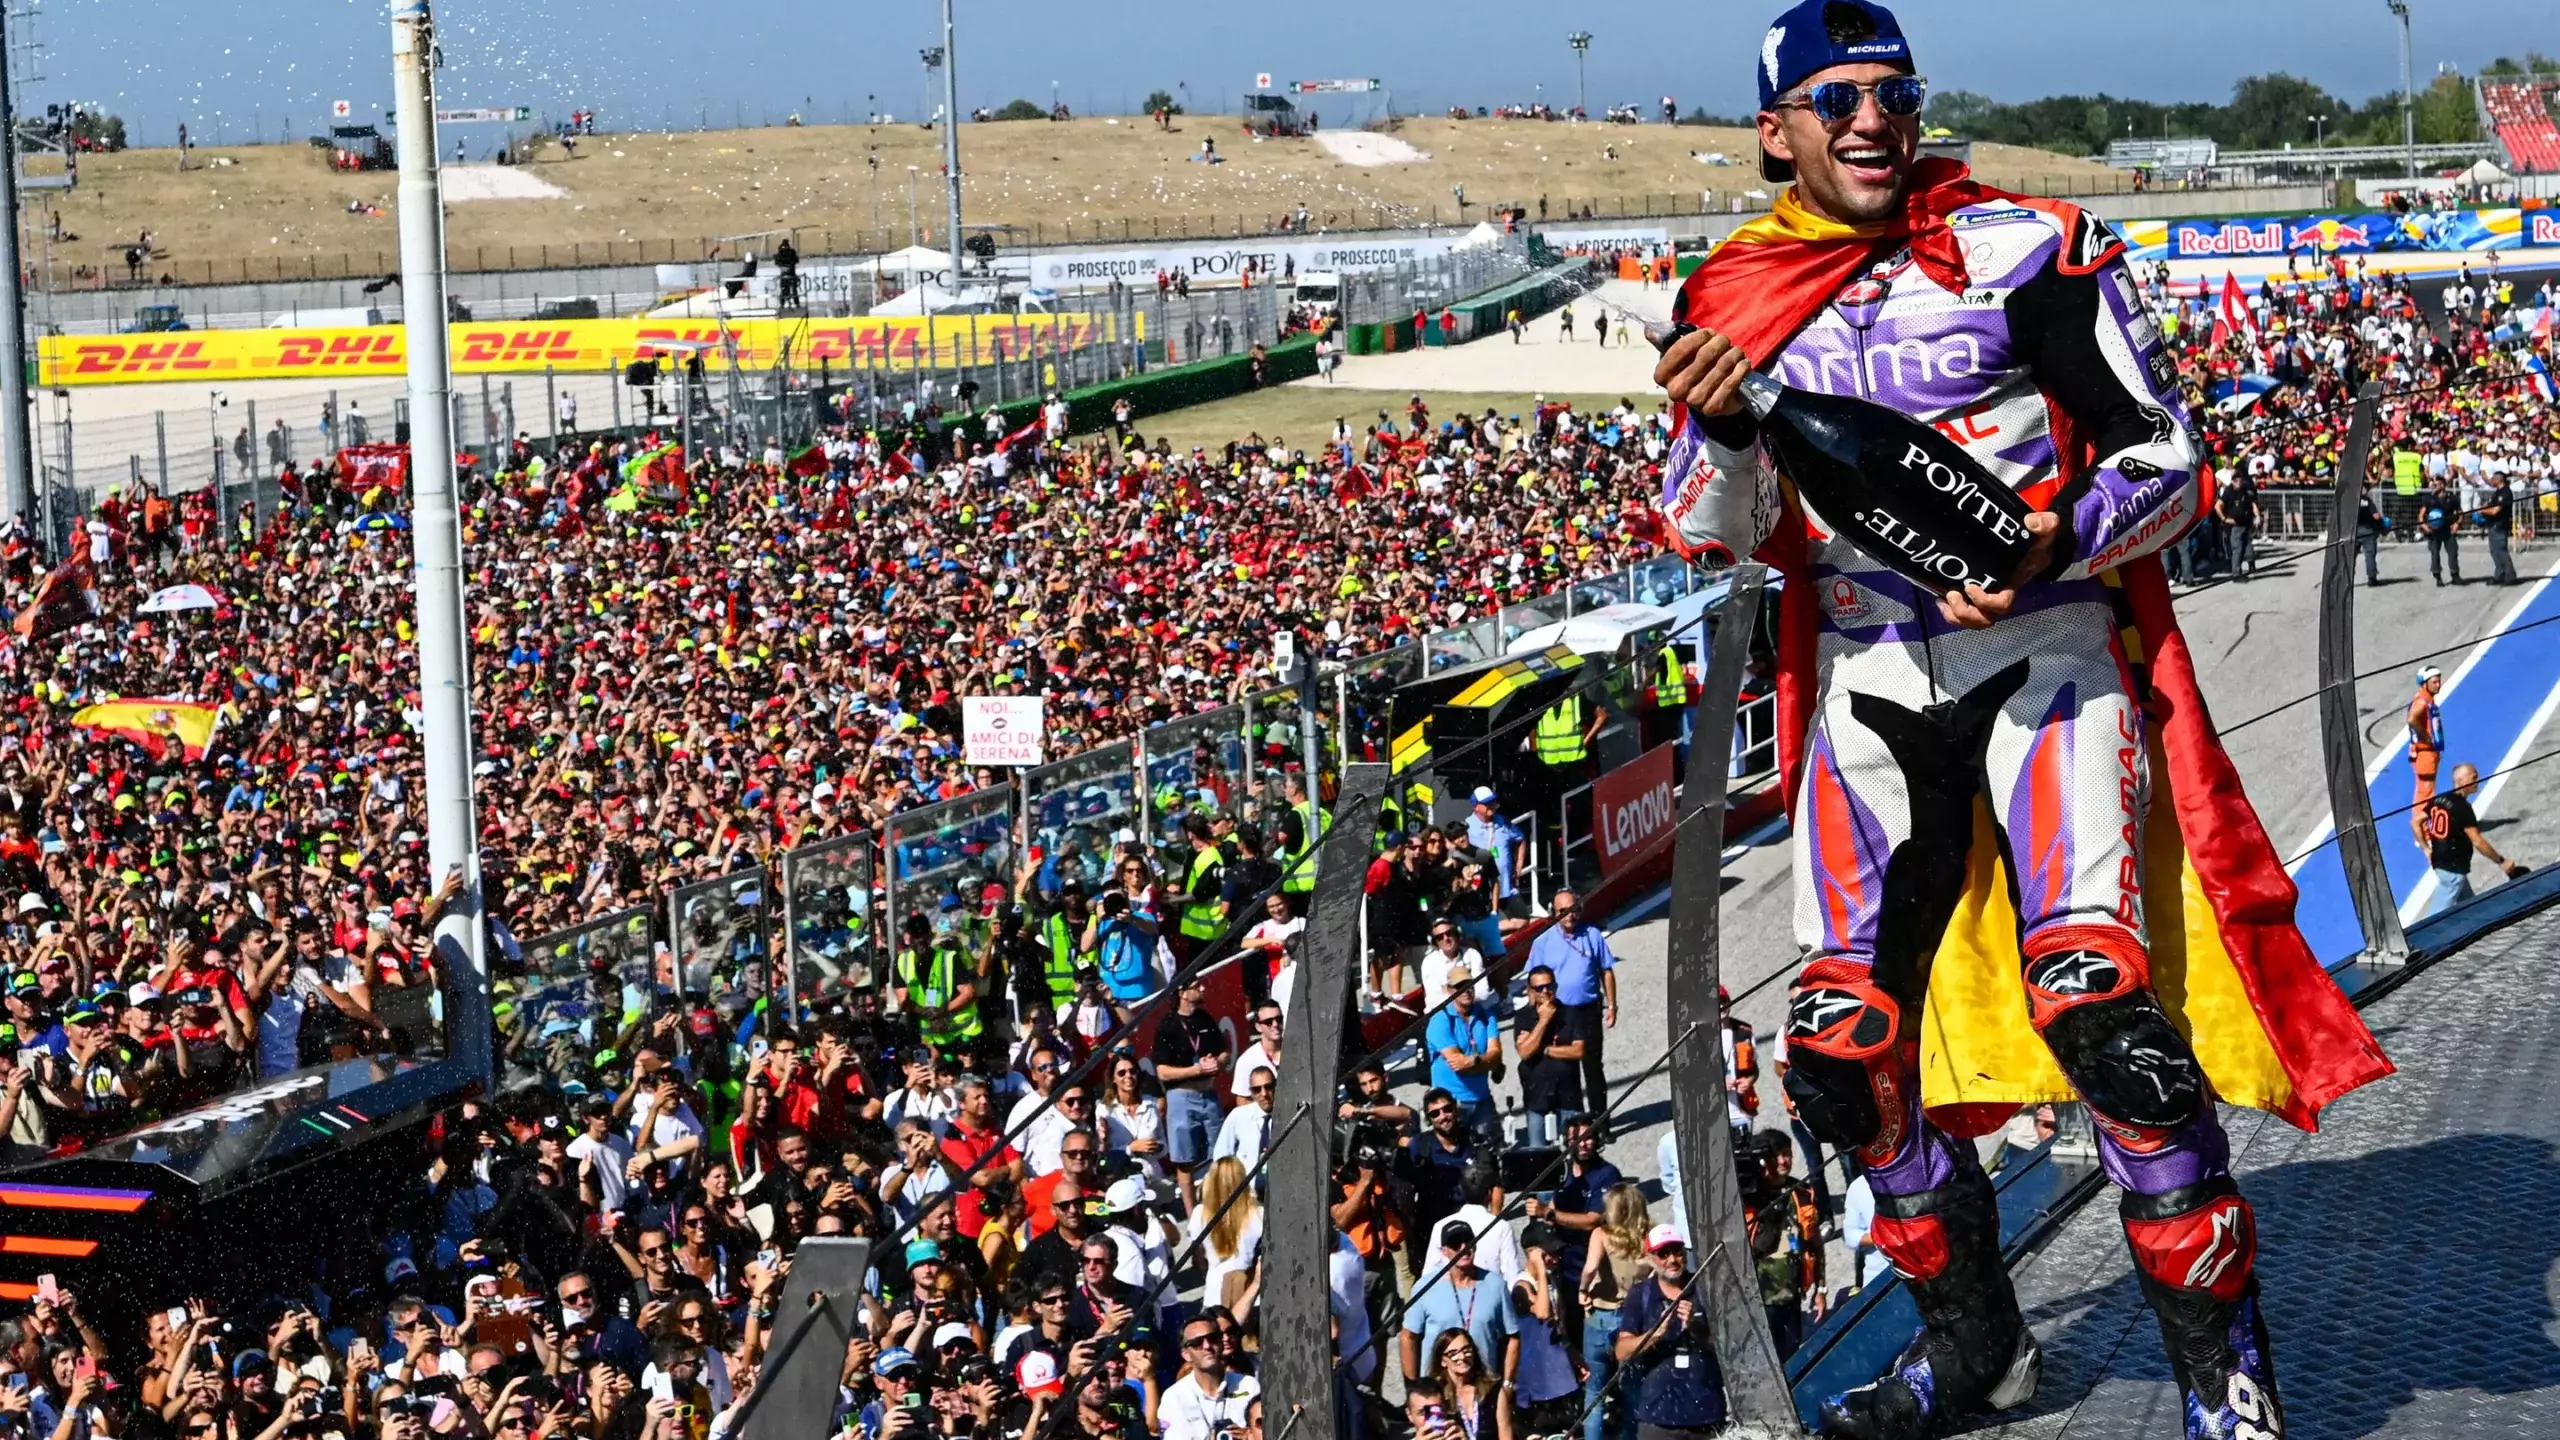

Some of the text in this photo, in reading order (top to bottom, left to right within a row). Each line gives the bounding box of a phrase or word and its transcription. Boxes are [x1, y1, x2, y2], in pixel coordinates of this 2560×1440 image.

[1847, 43, 1900, 54] MICHELIN
[1971, 210, 2029, 223] MICHELIN
[2180, 223, 2282, 253] Red Bull
[1068, 260, 1136, 278] PROSECCO
[1331, 248, 1396, 266] PROSECCO
[76, 341, 213, 373] DHL
[277, 336, 401, 366] DHL
[462, 331, 578, 360] DHL
[810, 327, 929, 359] DHL
[2088, 496, 2184, 575] PRAMAC
[971, 732, 1034, 744] AMICI DI
[973, 747, 1031, 760] SERENA
[1602, 782, 1670, 857] Lenovo
[2115, 708, 2141, 930] PRAMAC
